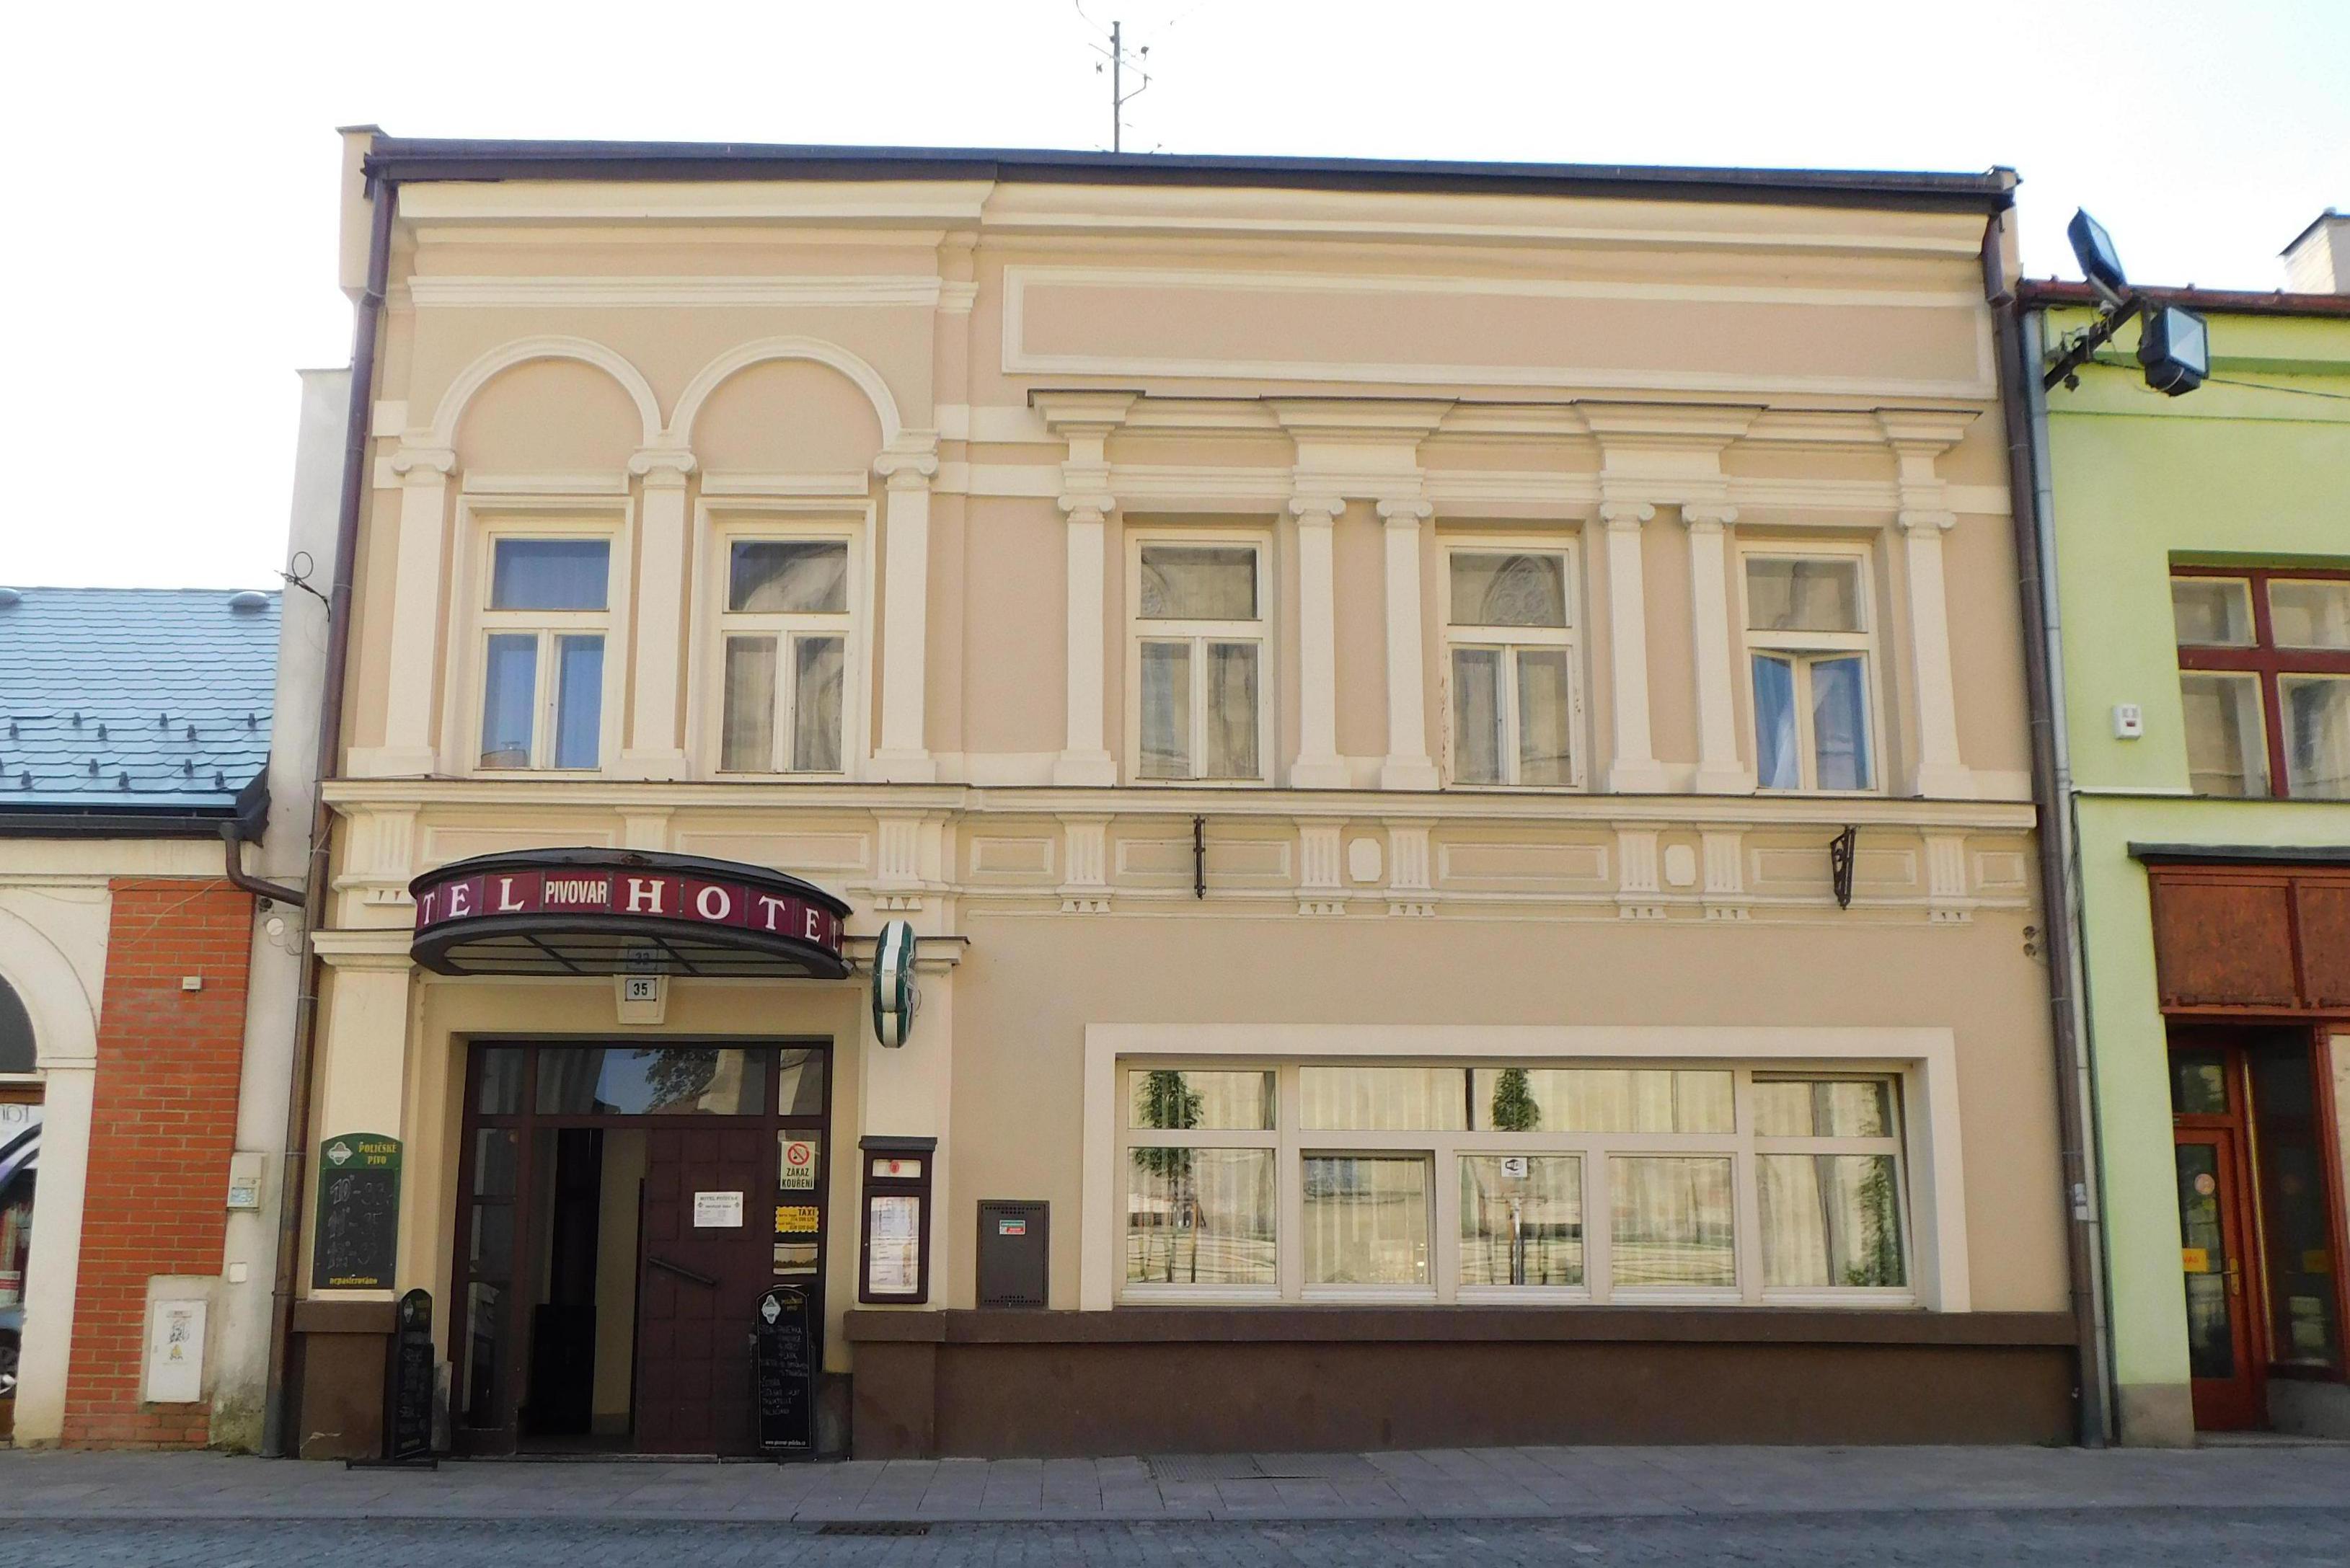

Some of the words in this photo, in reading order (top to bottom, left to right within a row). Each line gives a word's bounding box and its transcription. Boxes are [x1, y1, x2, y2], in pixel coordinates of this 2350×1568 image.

[544, 880, 607, 904] PIVOVAR
[626, 878, 839, 952] HOTEL
[633, 983, 648, 996] 35
[358, 1141, 398, 1153] POLIČSKÉ
[368, 1155, 387, 1165] PIVO
[786, 1166, 810, 1177] ZÁKAZ
[781, 1177, 814, 1189] KOUŘENÍ
